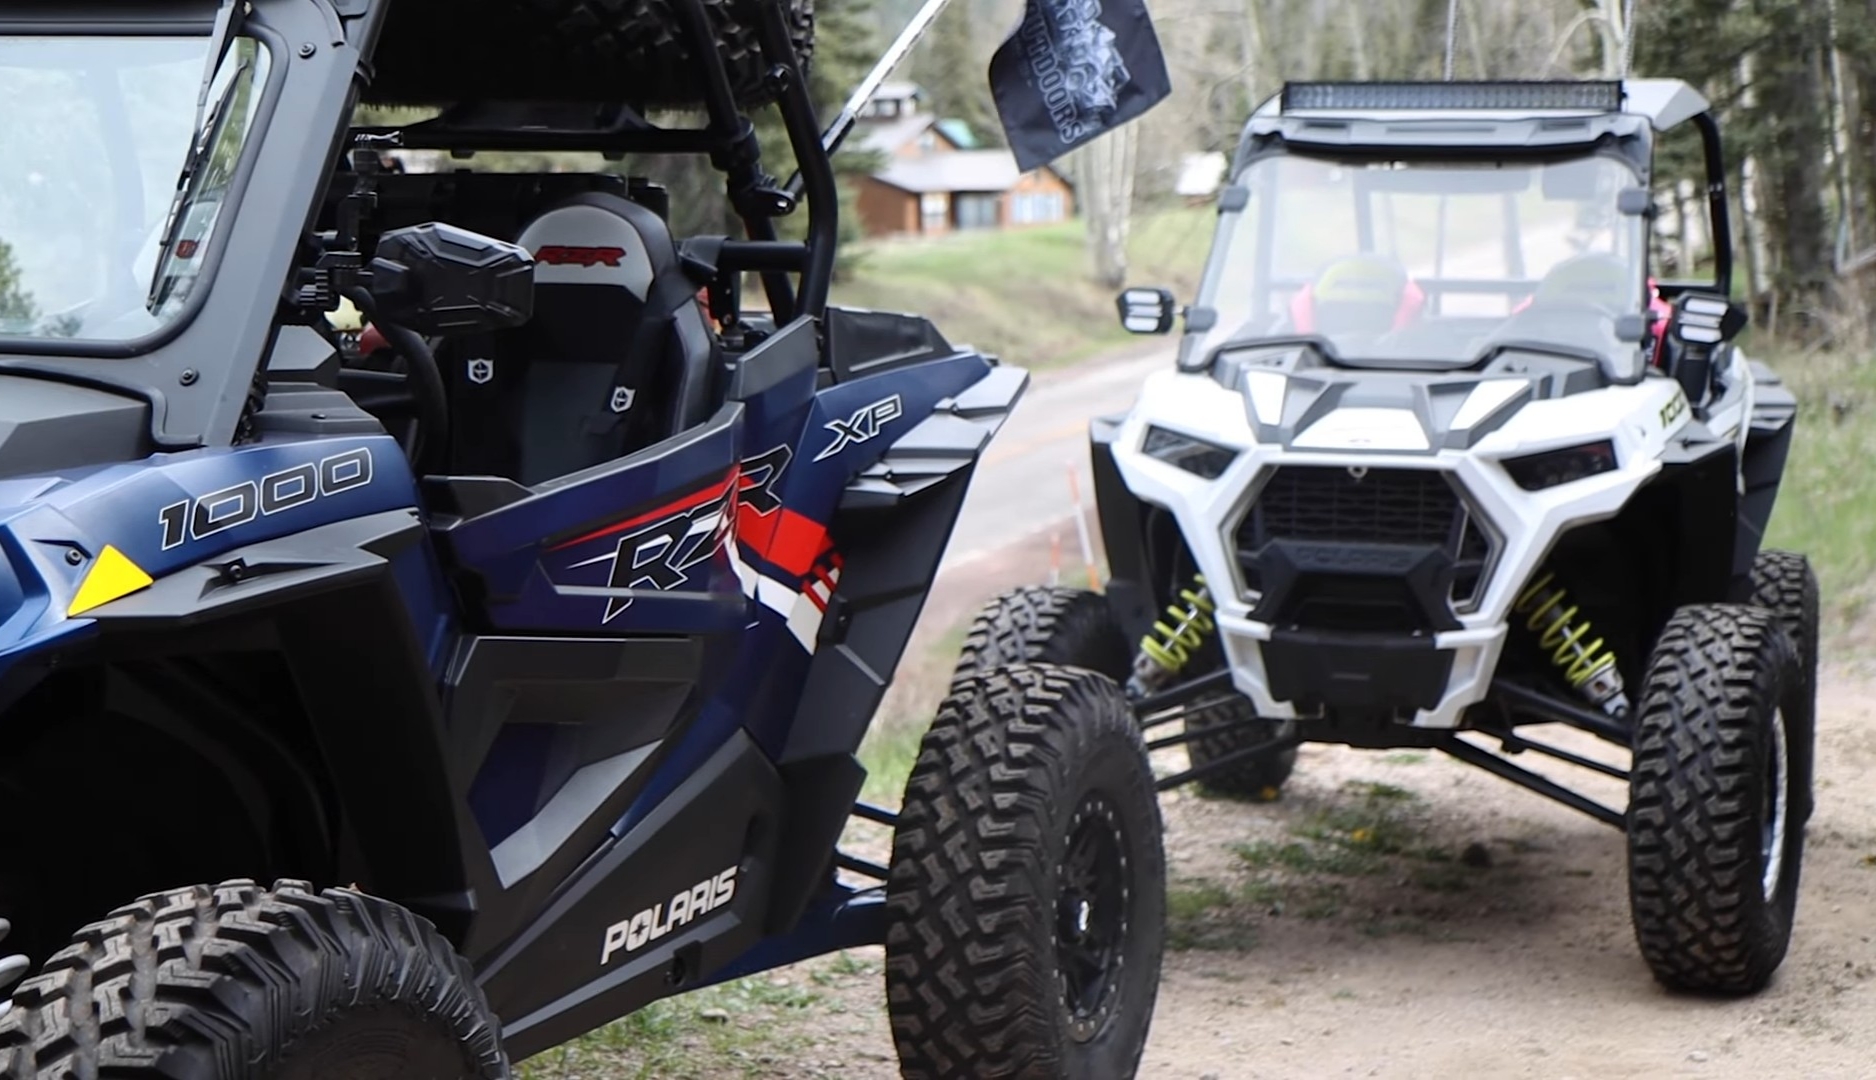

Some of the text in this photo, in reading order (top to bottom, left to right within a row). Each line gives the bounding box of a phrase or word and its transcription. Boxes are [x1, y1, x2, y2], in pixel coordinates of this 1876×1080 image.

[812, 393, 903, 463] XP
[158, 447, 373, 551] 1000
[600, 865, 738, 966] POLARIS
